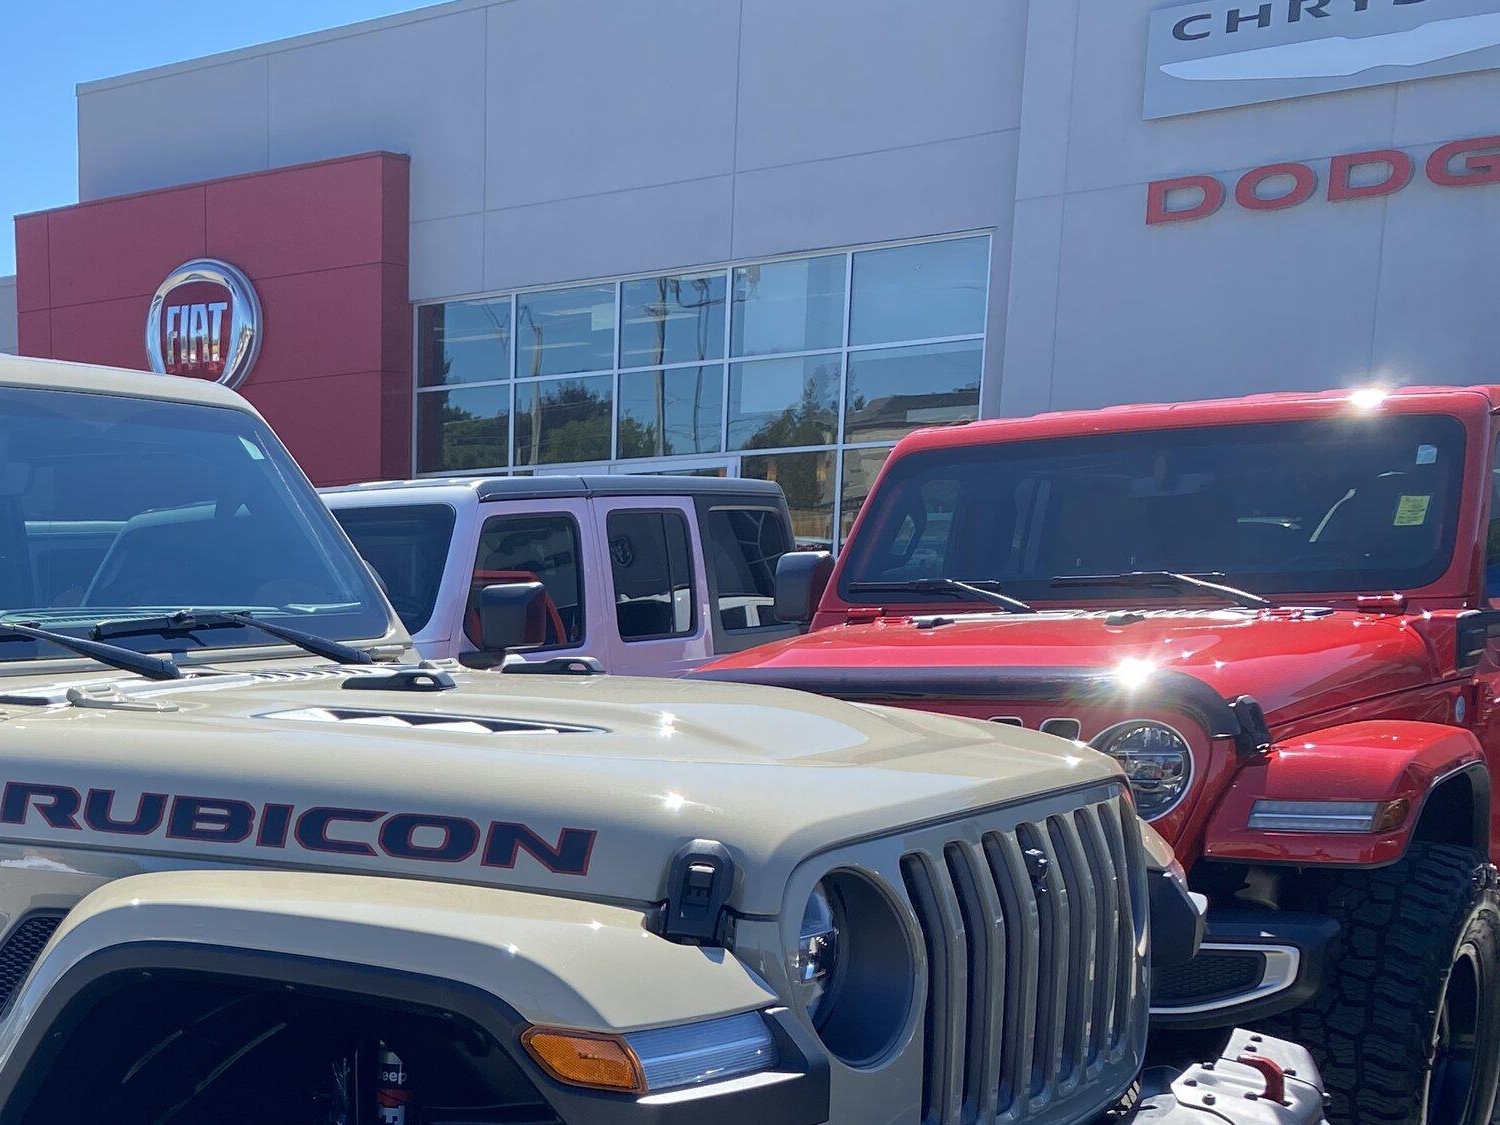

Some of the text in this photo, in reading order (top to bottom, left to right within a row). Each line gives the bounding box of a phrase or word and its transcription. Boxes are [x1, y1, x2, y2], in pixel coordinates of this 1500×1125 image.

[1172, 0, 1425, 41] CHR
[1145, 135, 1500, 225] DODG
[166, 301, 228, 365] FIAT
[0, 781, 598, 877] RUBICON
